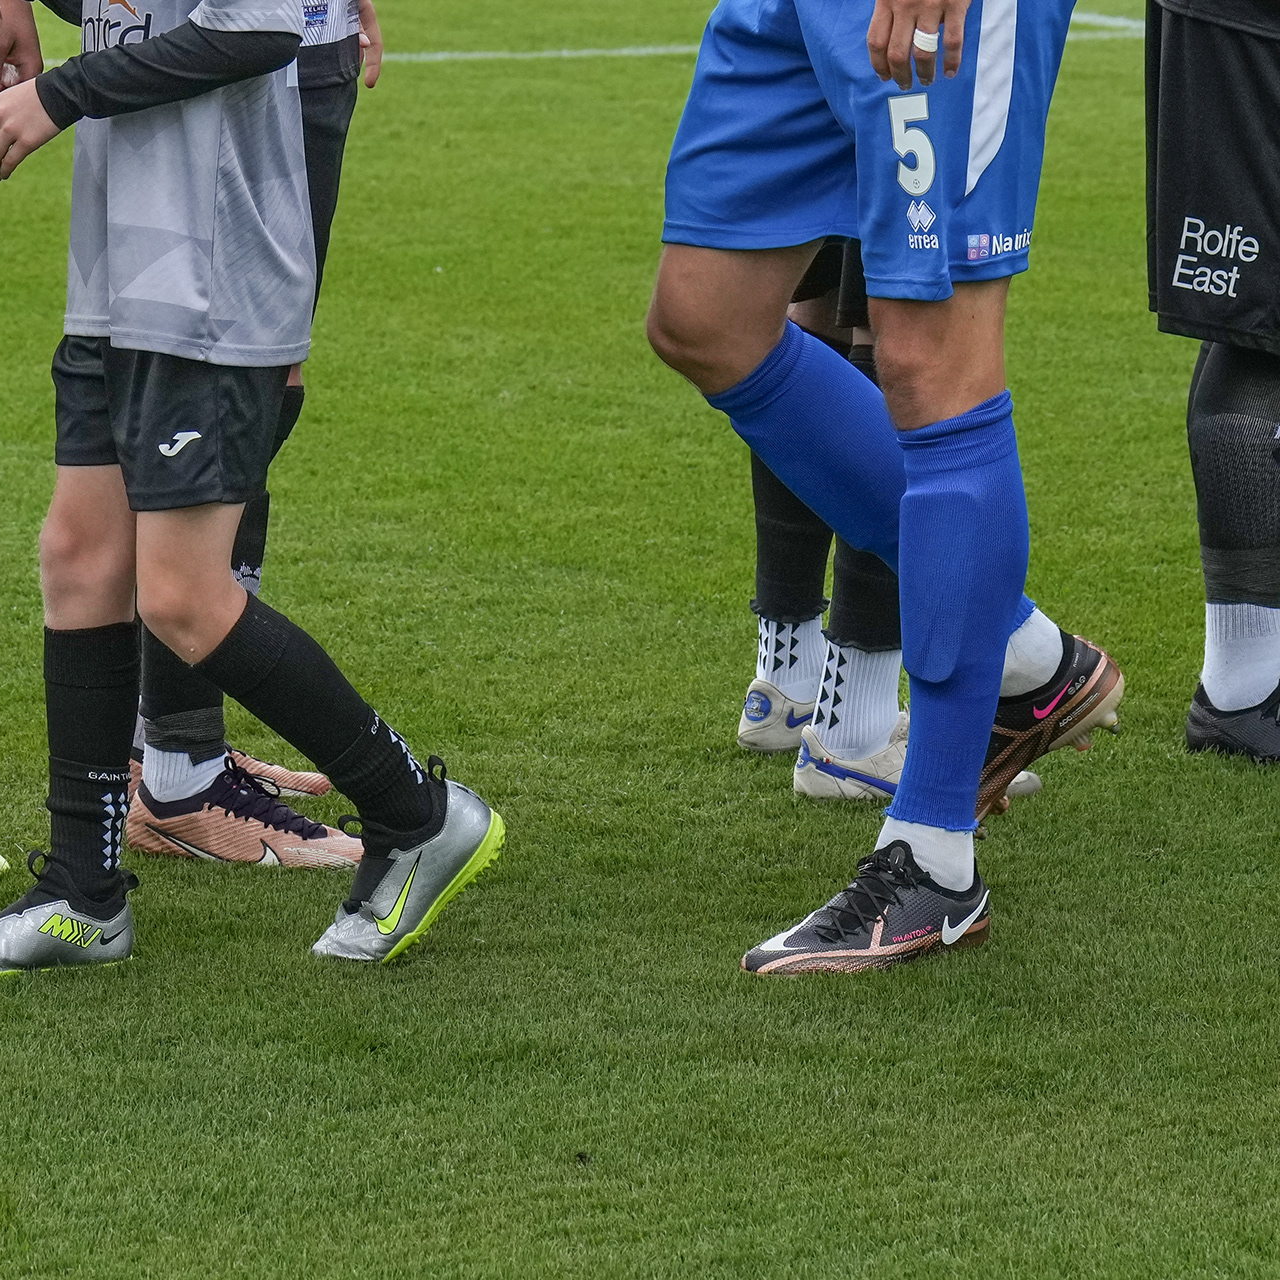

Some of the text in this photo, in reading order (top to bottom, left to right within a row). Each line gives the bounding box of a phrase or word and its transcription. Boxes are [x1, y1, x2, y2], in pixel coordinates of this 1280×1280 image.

[888, 93, 936, 196] 5
[908, 232, 939, 250] errea
[1180, 217, 1259, 261] Rolfe
[1172, 254, 1240, 298] East
